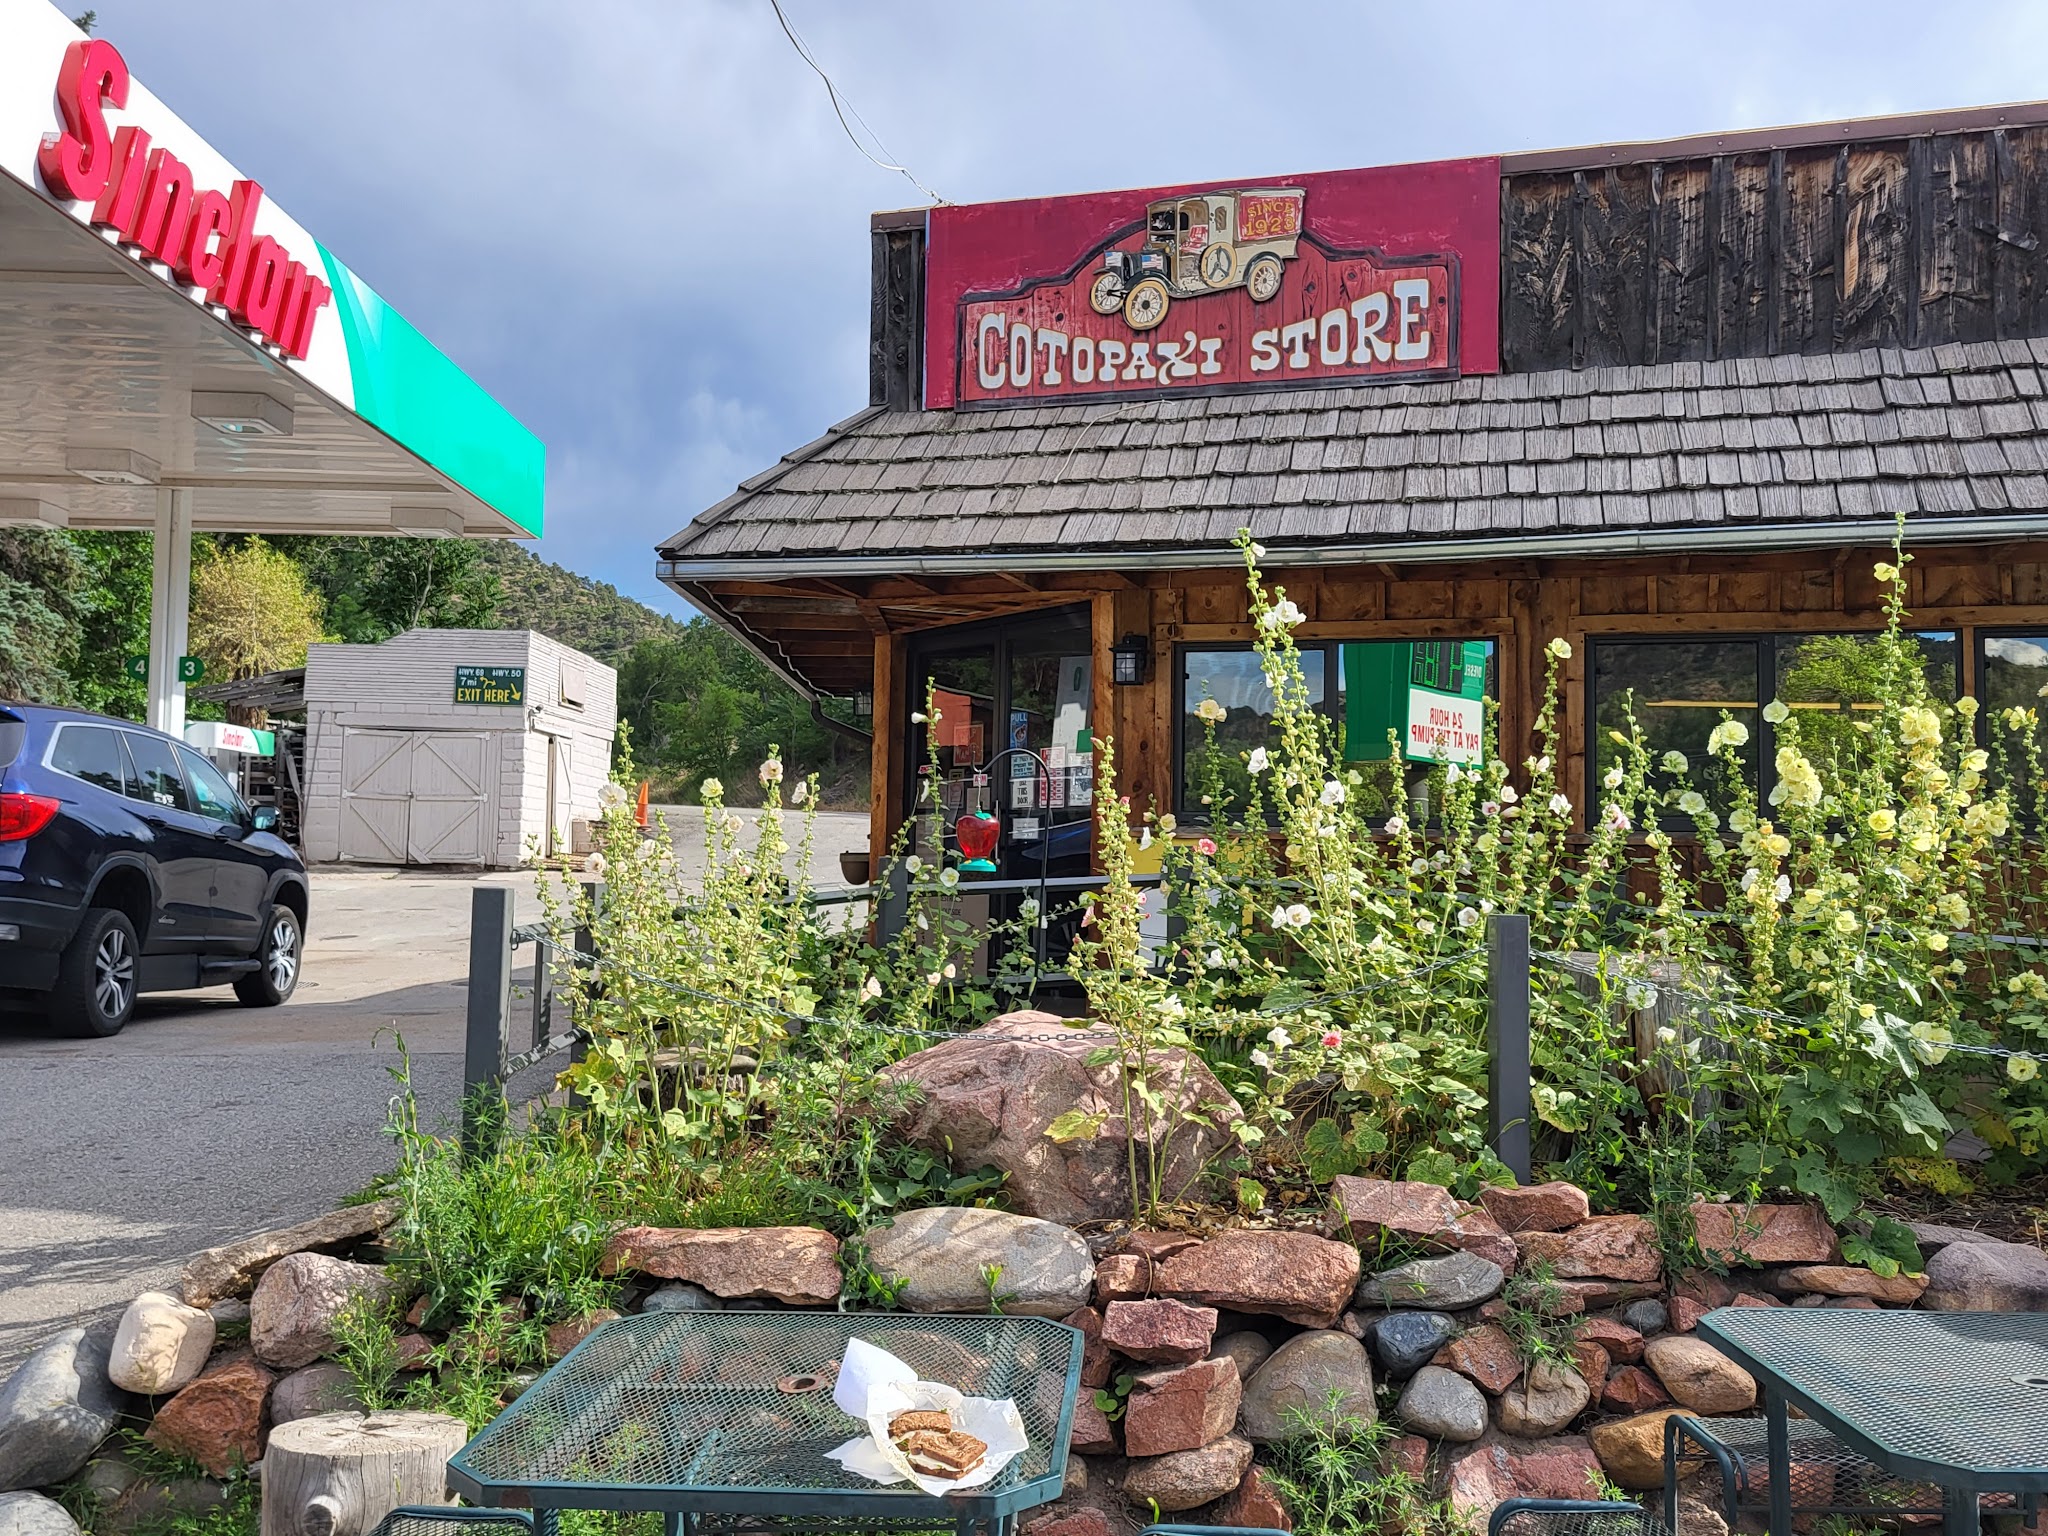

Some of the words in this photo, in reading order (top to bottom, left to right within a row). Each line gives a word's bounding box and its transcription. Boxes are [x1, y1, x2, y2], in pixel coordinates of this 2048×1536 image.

[38, 39, 332, 361] Sinclair
[1247, 202, 1295, 218] SINCE
[1246, 216, 1295, 236] 1923
[978, 312, 1223, 389] COTOPAXI
[1250, 278, 1431, 373] STORE
[135, 660, 146, 674] 4
[185, 661, 195, 676] 3
[460, 677, 467, 686] 7
[467, 677, 477, 686] mi
[458, 688, 482, 702] EXIT
[484, 689, 511, 703] HERE
[1011, 713, 1028, 722] PULL
